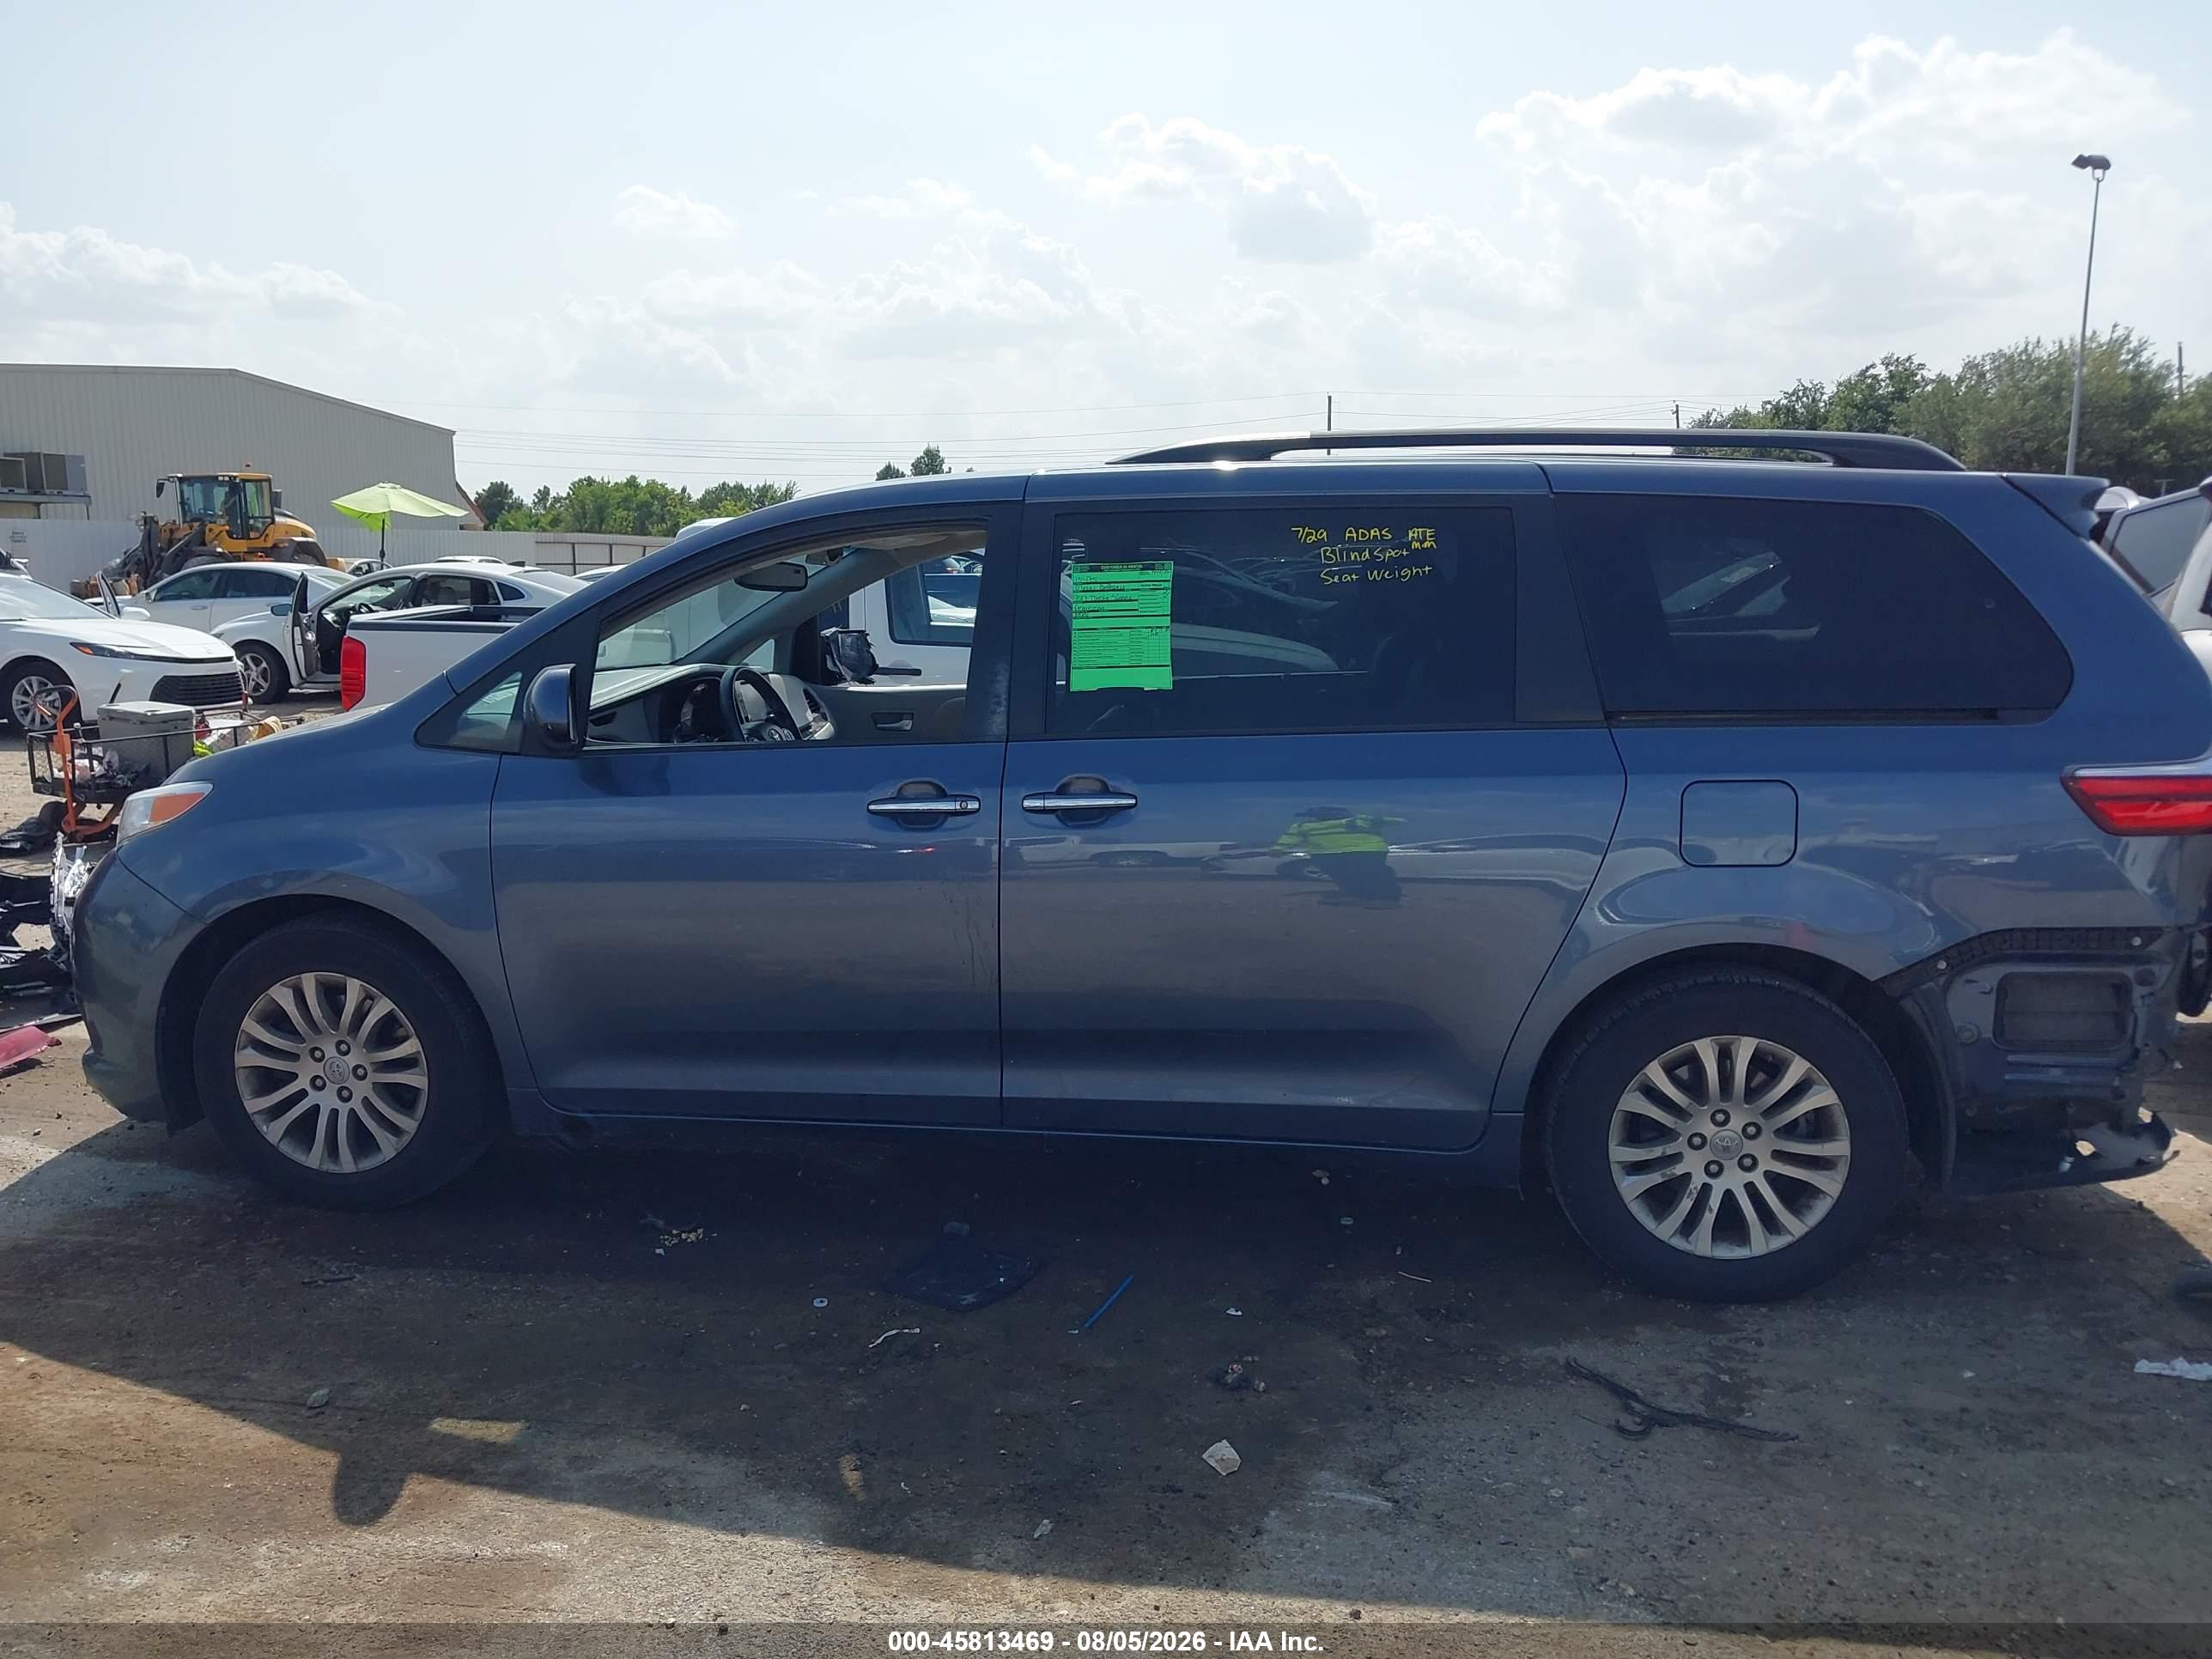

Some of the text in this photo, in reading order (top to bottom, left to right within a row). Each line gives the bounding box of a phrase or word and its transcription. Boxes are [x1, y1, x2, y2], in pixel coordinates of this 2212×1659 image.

[1345, 527, 1393, 542] ADAS
[1320, 565, 1433, 585] Seat Weight
